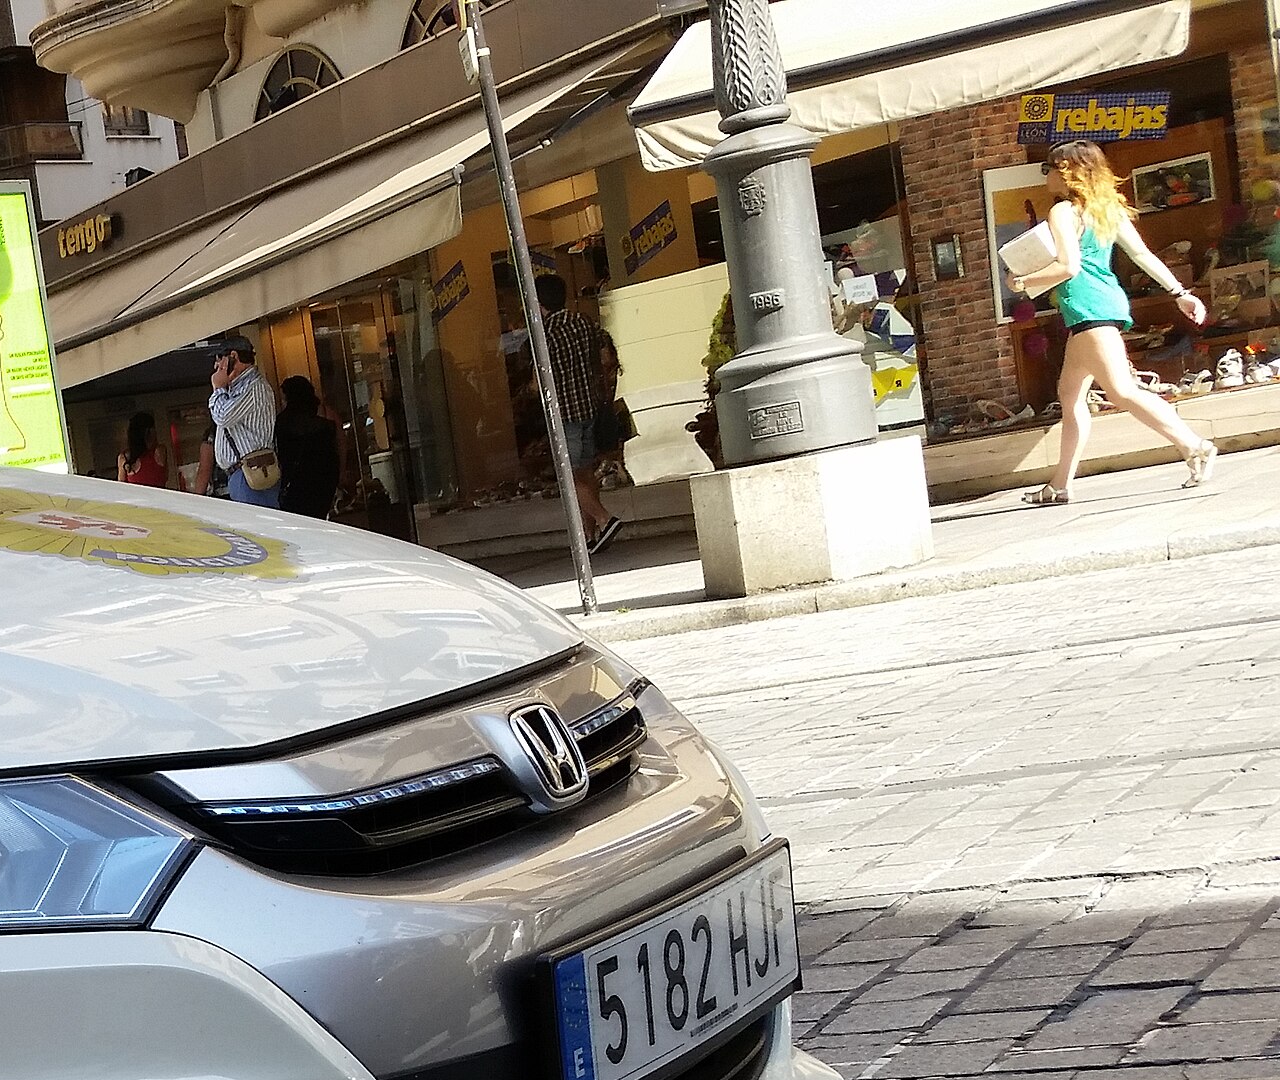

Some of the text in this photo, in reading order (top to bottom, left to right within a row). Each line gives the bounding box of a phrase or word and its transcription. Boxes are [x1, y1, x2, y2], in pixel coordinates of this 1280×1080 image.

[1055, 98, 1168, 139] rebajas
[57, 213, 109, 259] tengo
[633, 211, 675, 257] rebajas
[751, 293, 781, 310] 1996
[596, 914, 717, 1065] 5182
[573, 1046, 586, 1079] E
